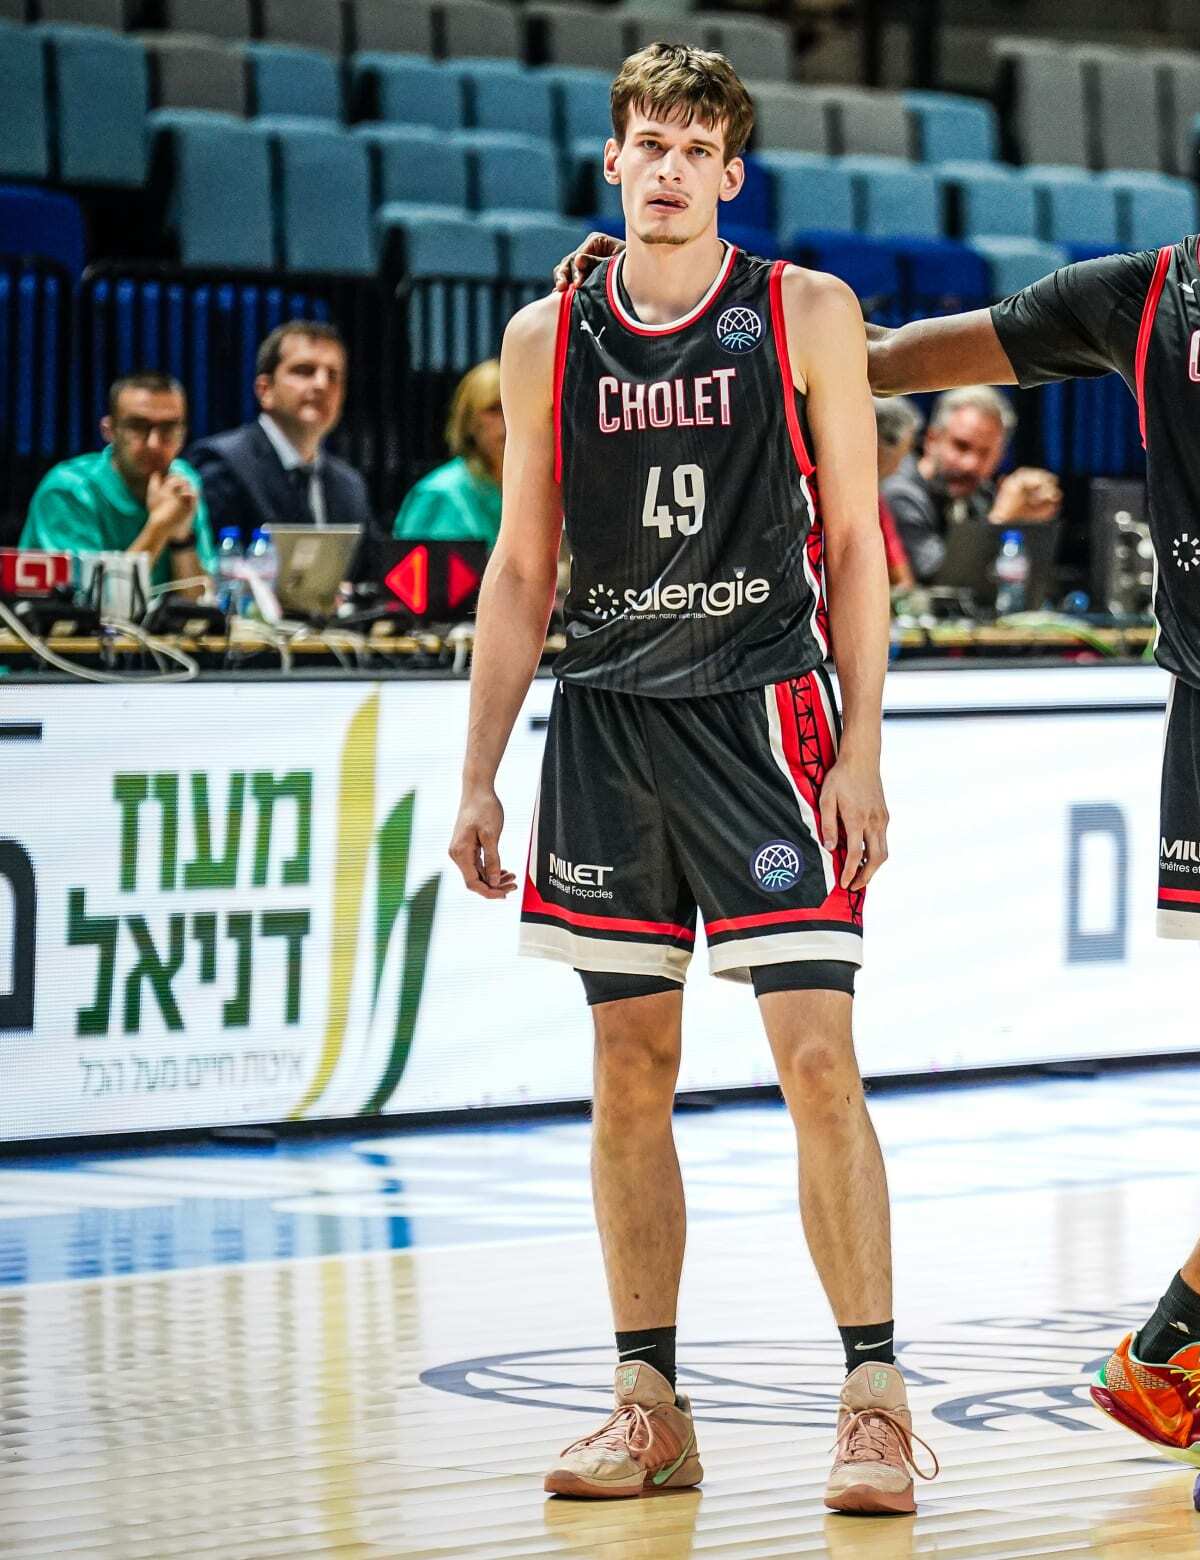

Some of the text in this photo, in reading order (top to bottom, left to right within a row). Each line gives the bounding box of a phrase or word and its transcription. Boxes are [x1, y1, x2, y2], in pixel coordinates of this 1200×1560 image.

[598, 367, 737, 434] CHOLET
[641, 463, 706, 539] 49
[623, 570, 771, 616] solengie
[112, 769, 315, 893] מעוז
[549, 852, 614, 887] MILLET
[571, 885, 613, 900] Façades
[65, 886, 312, 1038] דניאל
